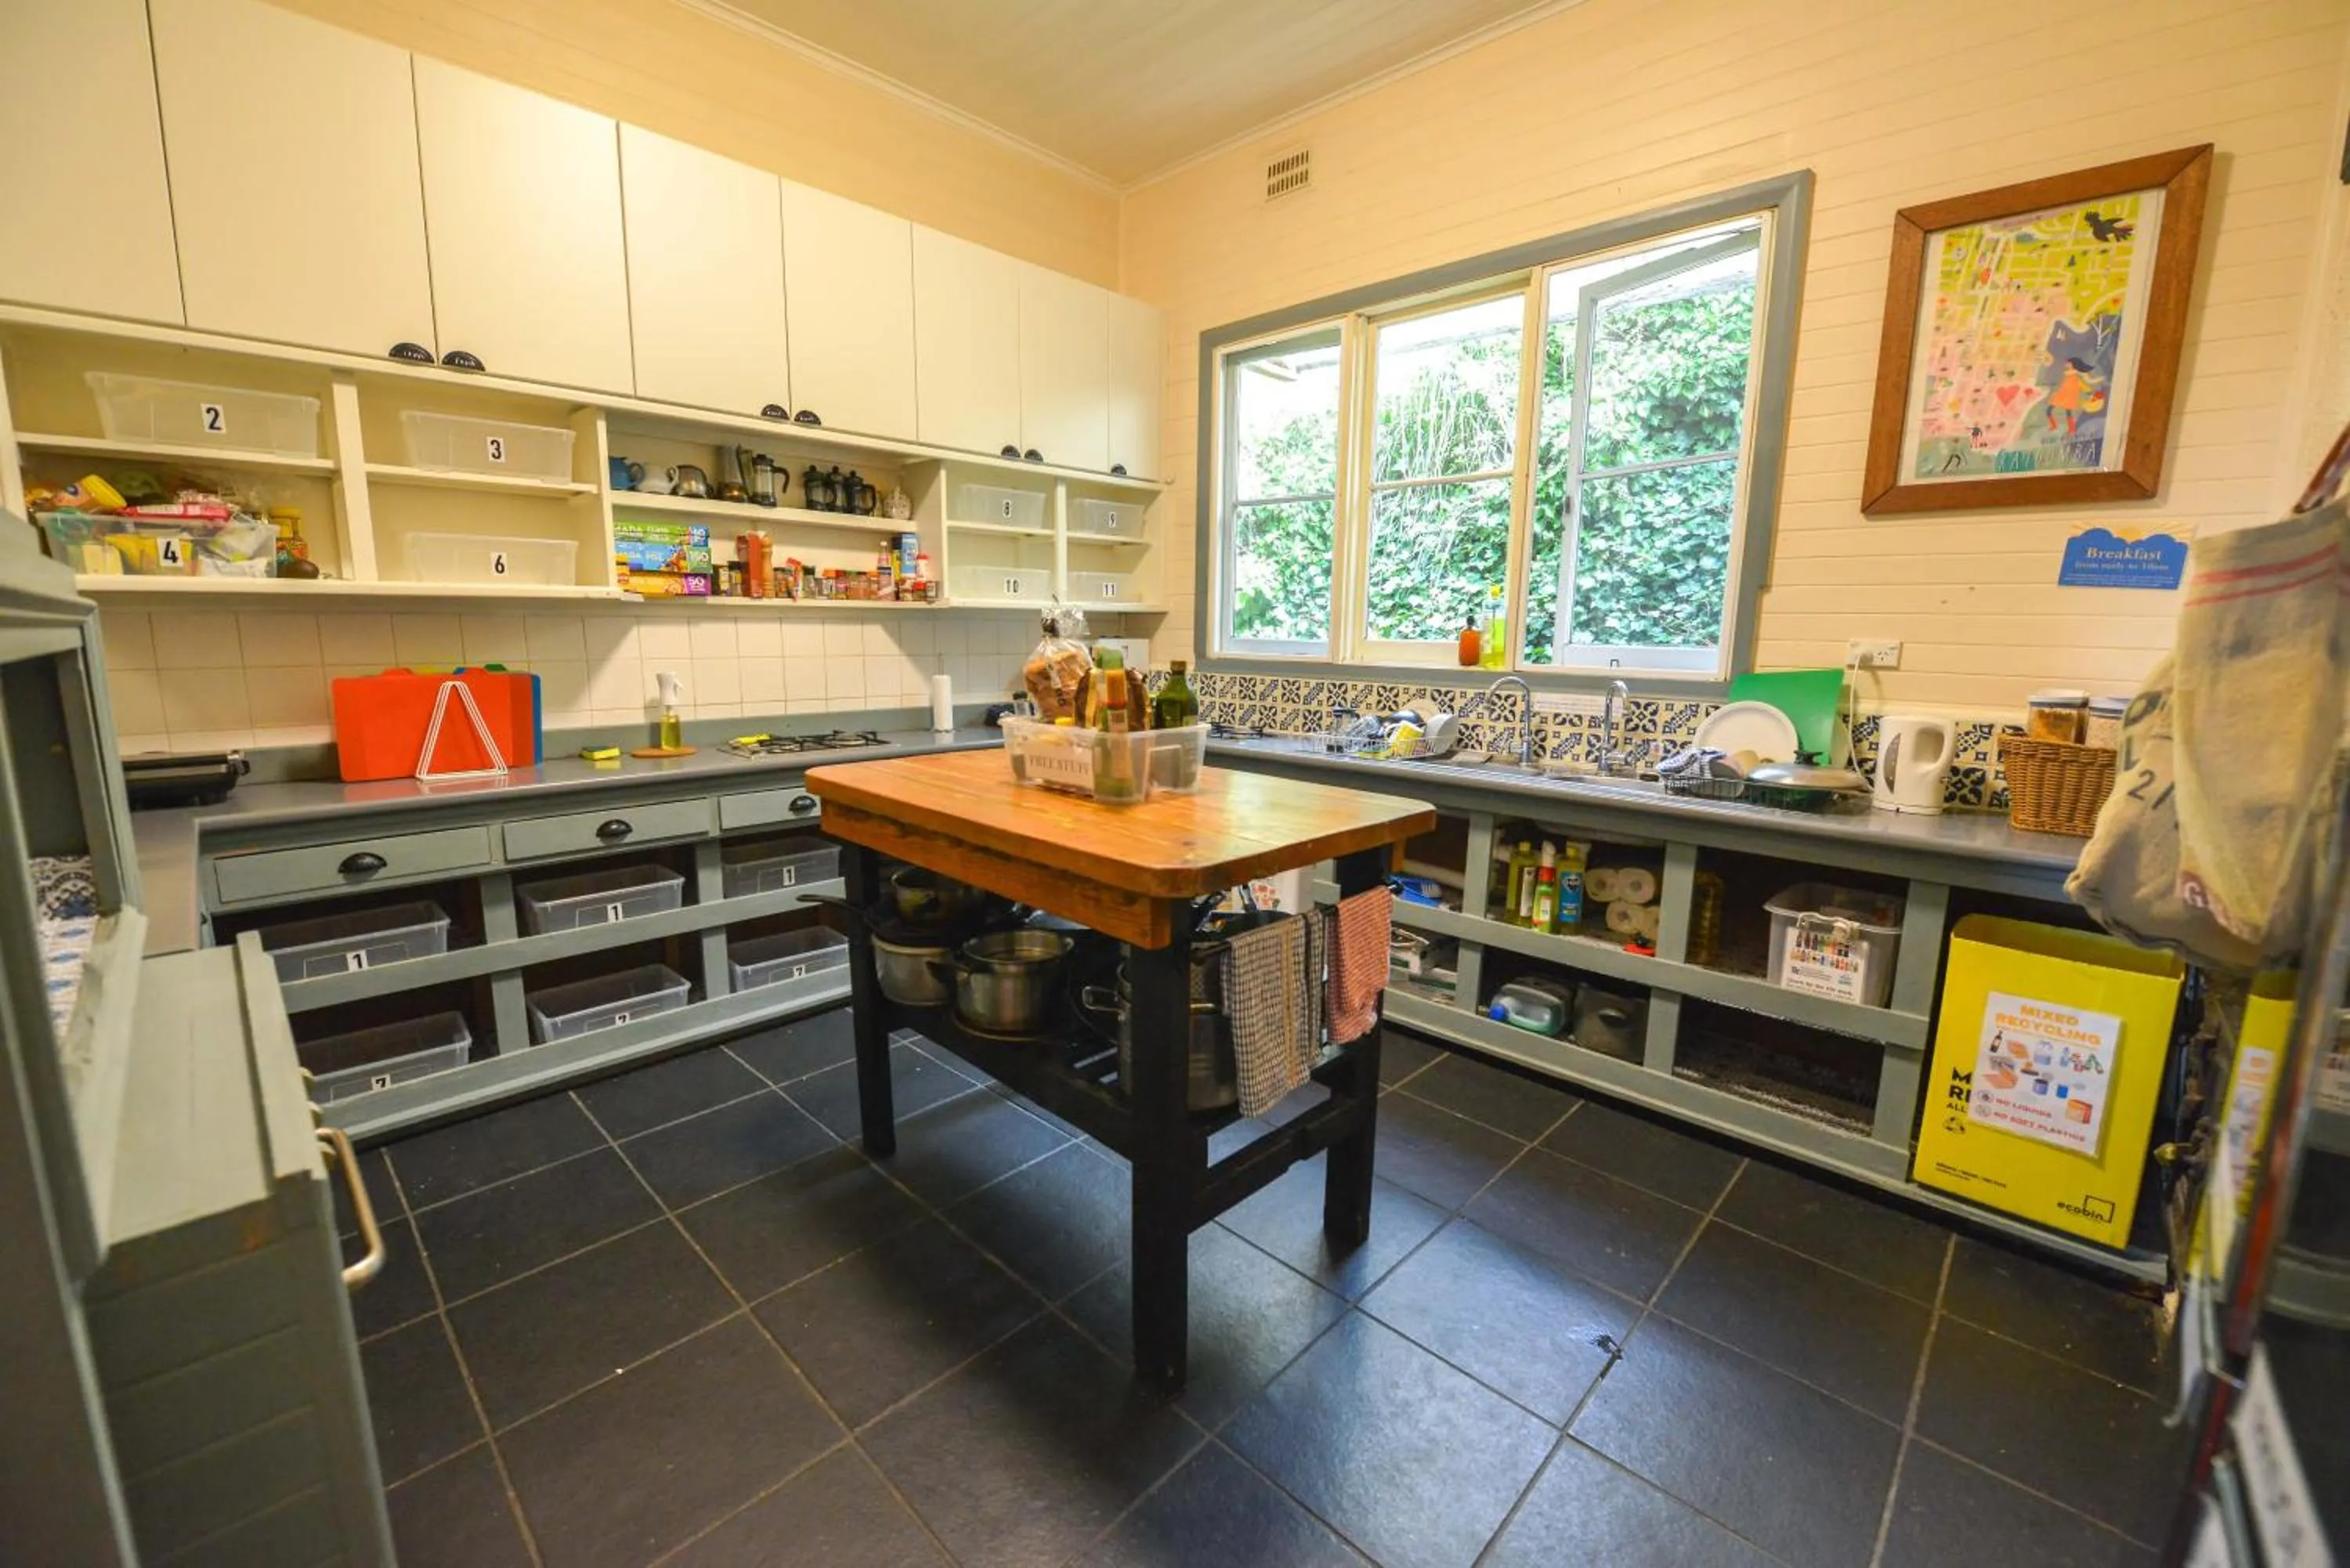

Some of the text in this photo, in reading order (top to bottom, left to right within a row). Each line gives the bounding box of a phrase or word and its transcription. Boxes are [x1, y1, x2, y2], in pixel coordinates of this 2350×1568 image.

[206, 406, 221, 430] 2
[490, 439, 502, 459] 3
[163, 540, 179, 564] 4
[2086, 547, 2162, 560] Breakfast
[494, 555, 505, 574] 6
[1006, 579, 1019, 593] 10
[1104, 583, 1115, 596] 11
[786, 868, 792, 883] 1
[611, 905, 619, 921] 1
[352, 953, 363, 970] 1
[2020, 1004, 2080, 1026] MIXED
[1995, 1013, 2102, 1046] RECYCLING
[375, 1077, 387, 1089] 7
[1946, 1102, 1967, 1113] ALL
[2057, 1199, 2105, 1220] ecobin
